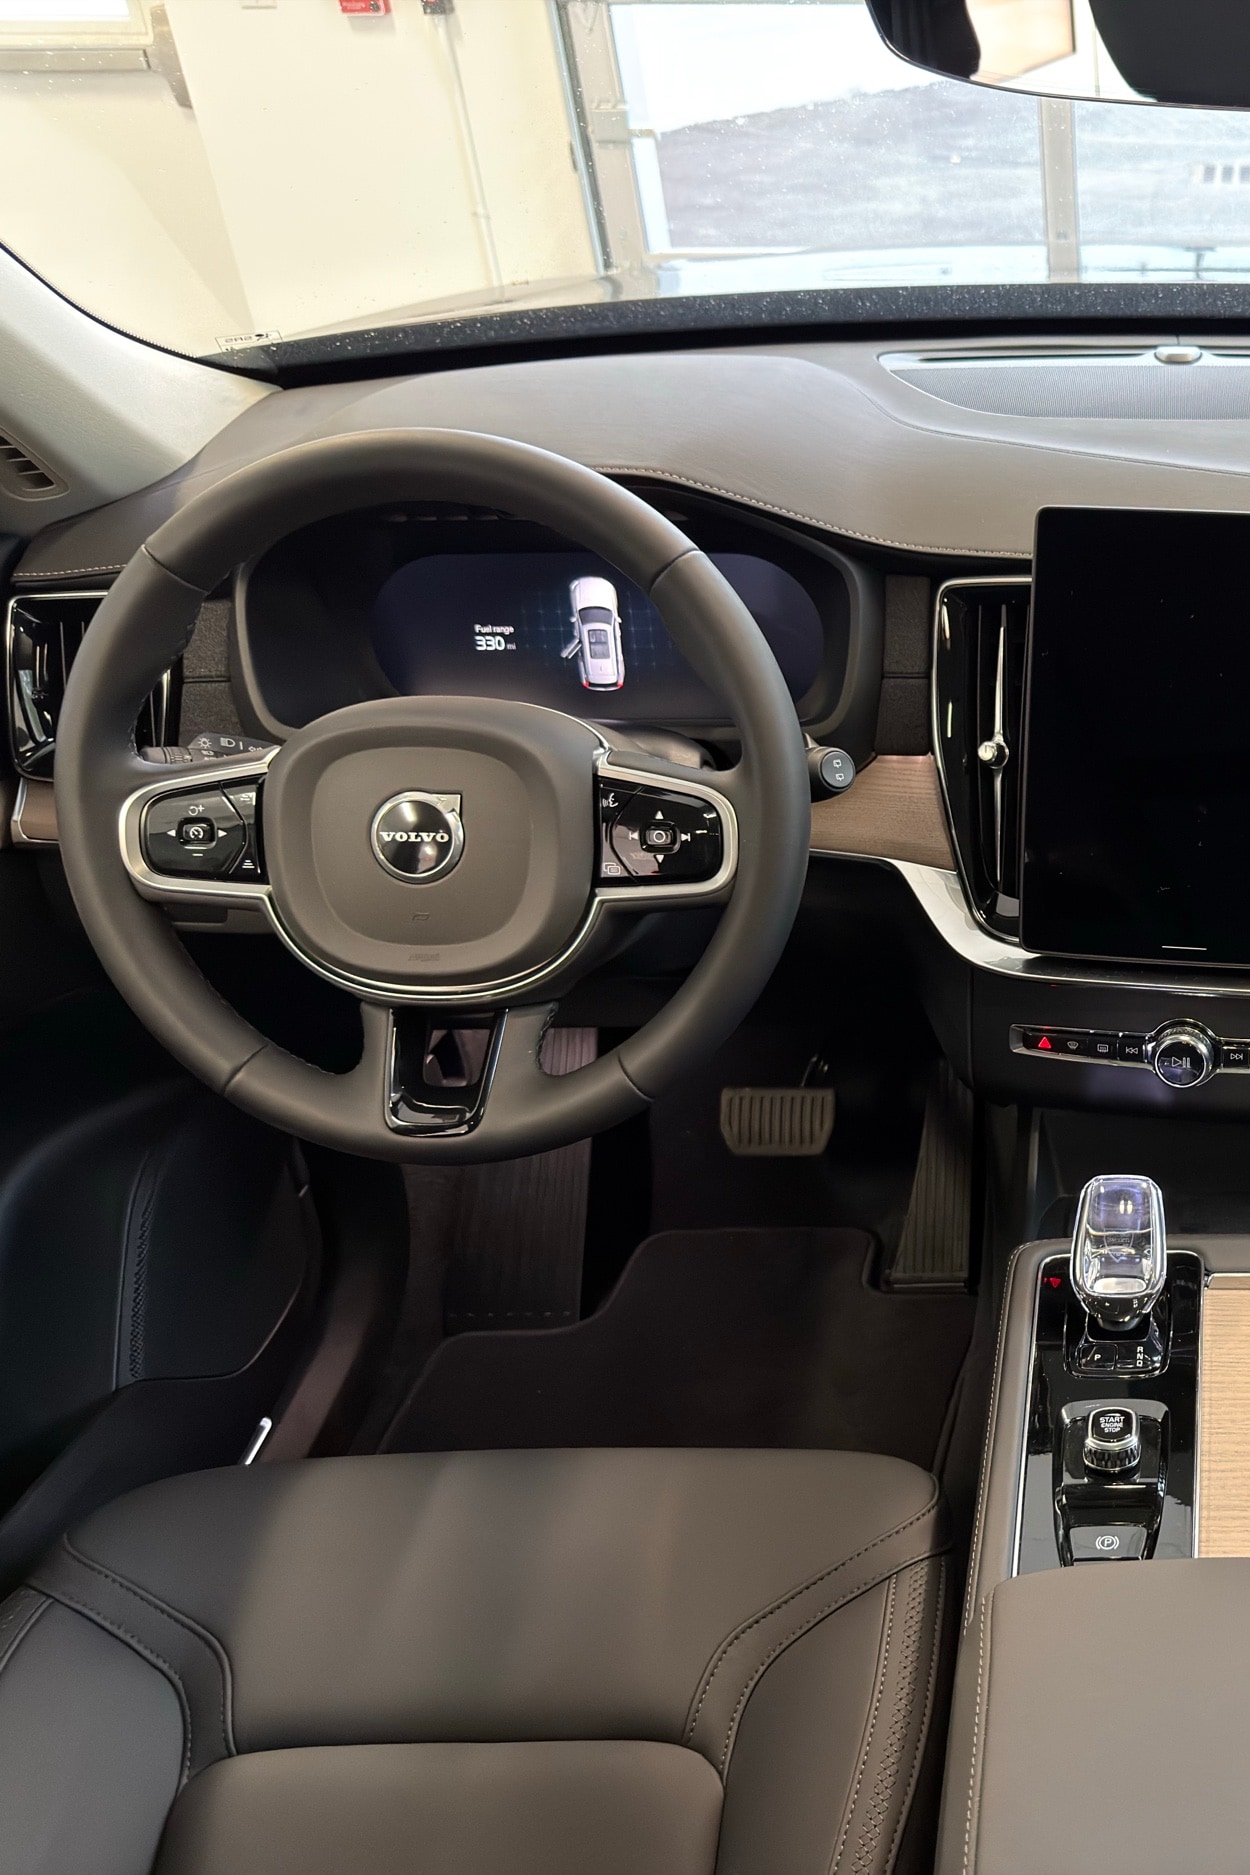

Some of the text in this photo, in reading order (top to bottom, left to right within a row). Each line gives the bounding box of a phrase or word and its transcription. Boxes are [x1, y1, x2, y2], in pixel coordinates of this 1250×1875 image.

[474, 624, 514, 635] Fuel range
[474, 636, 505, 650] 330
[379, 831, 449, 842] VOLVO
